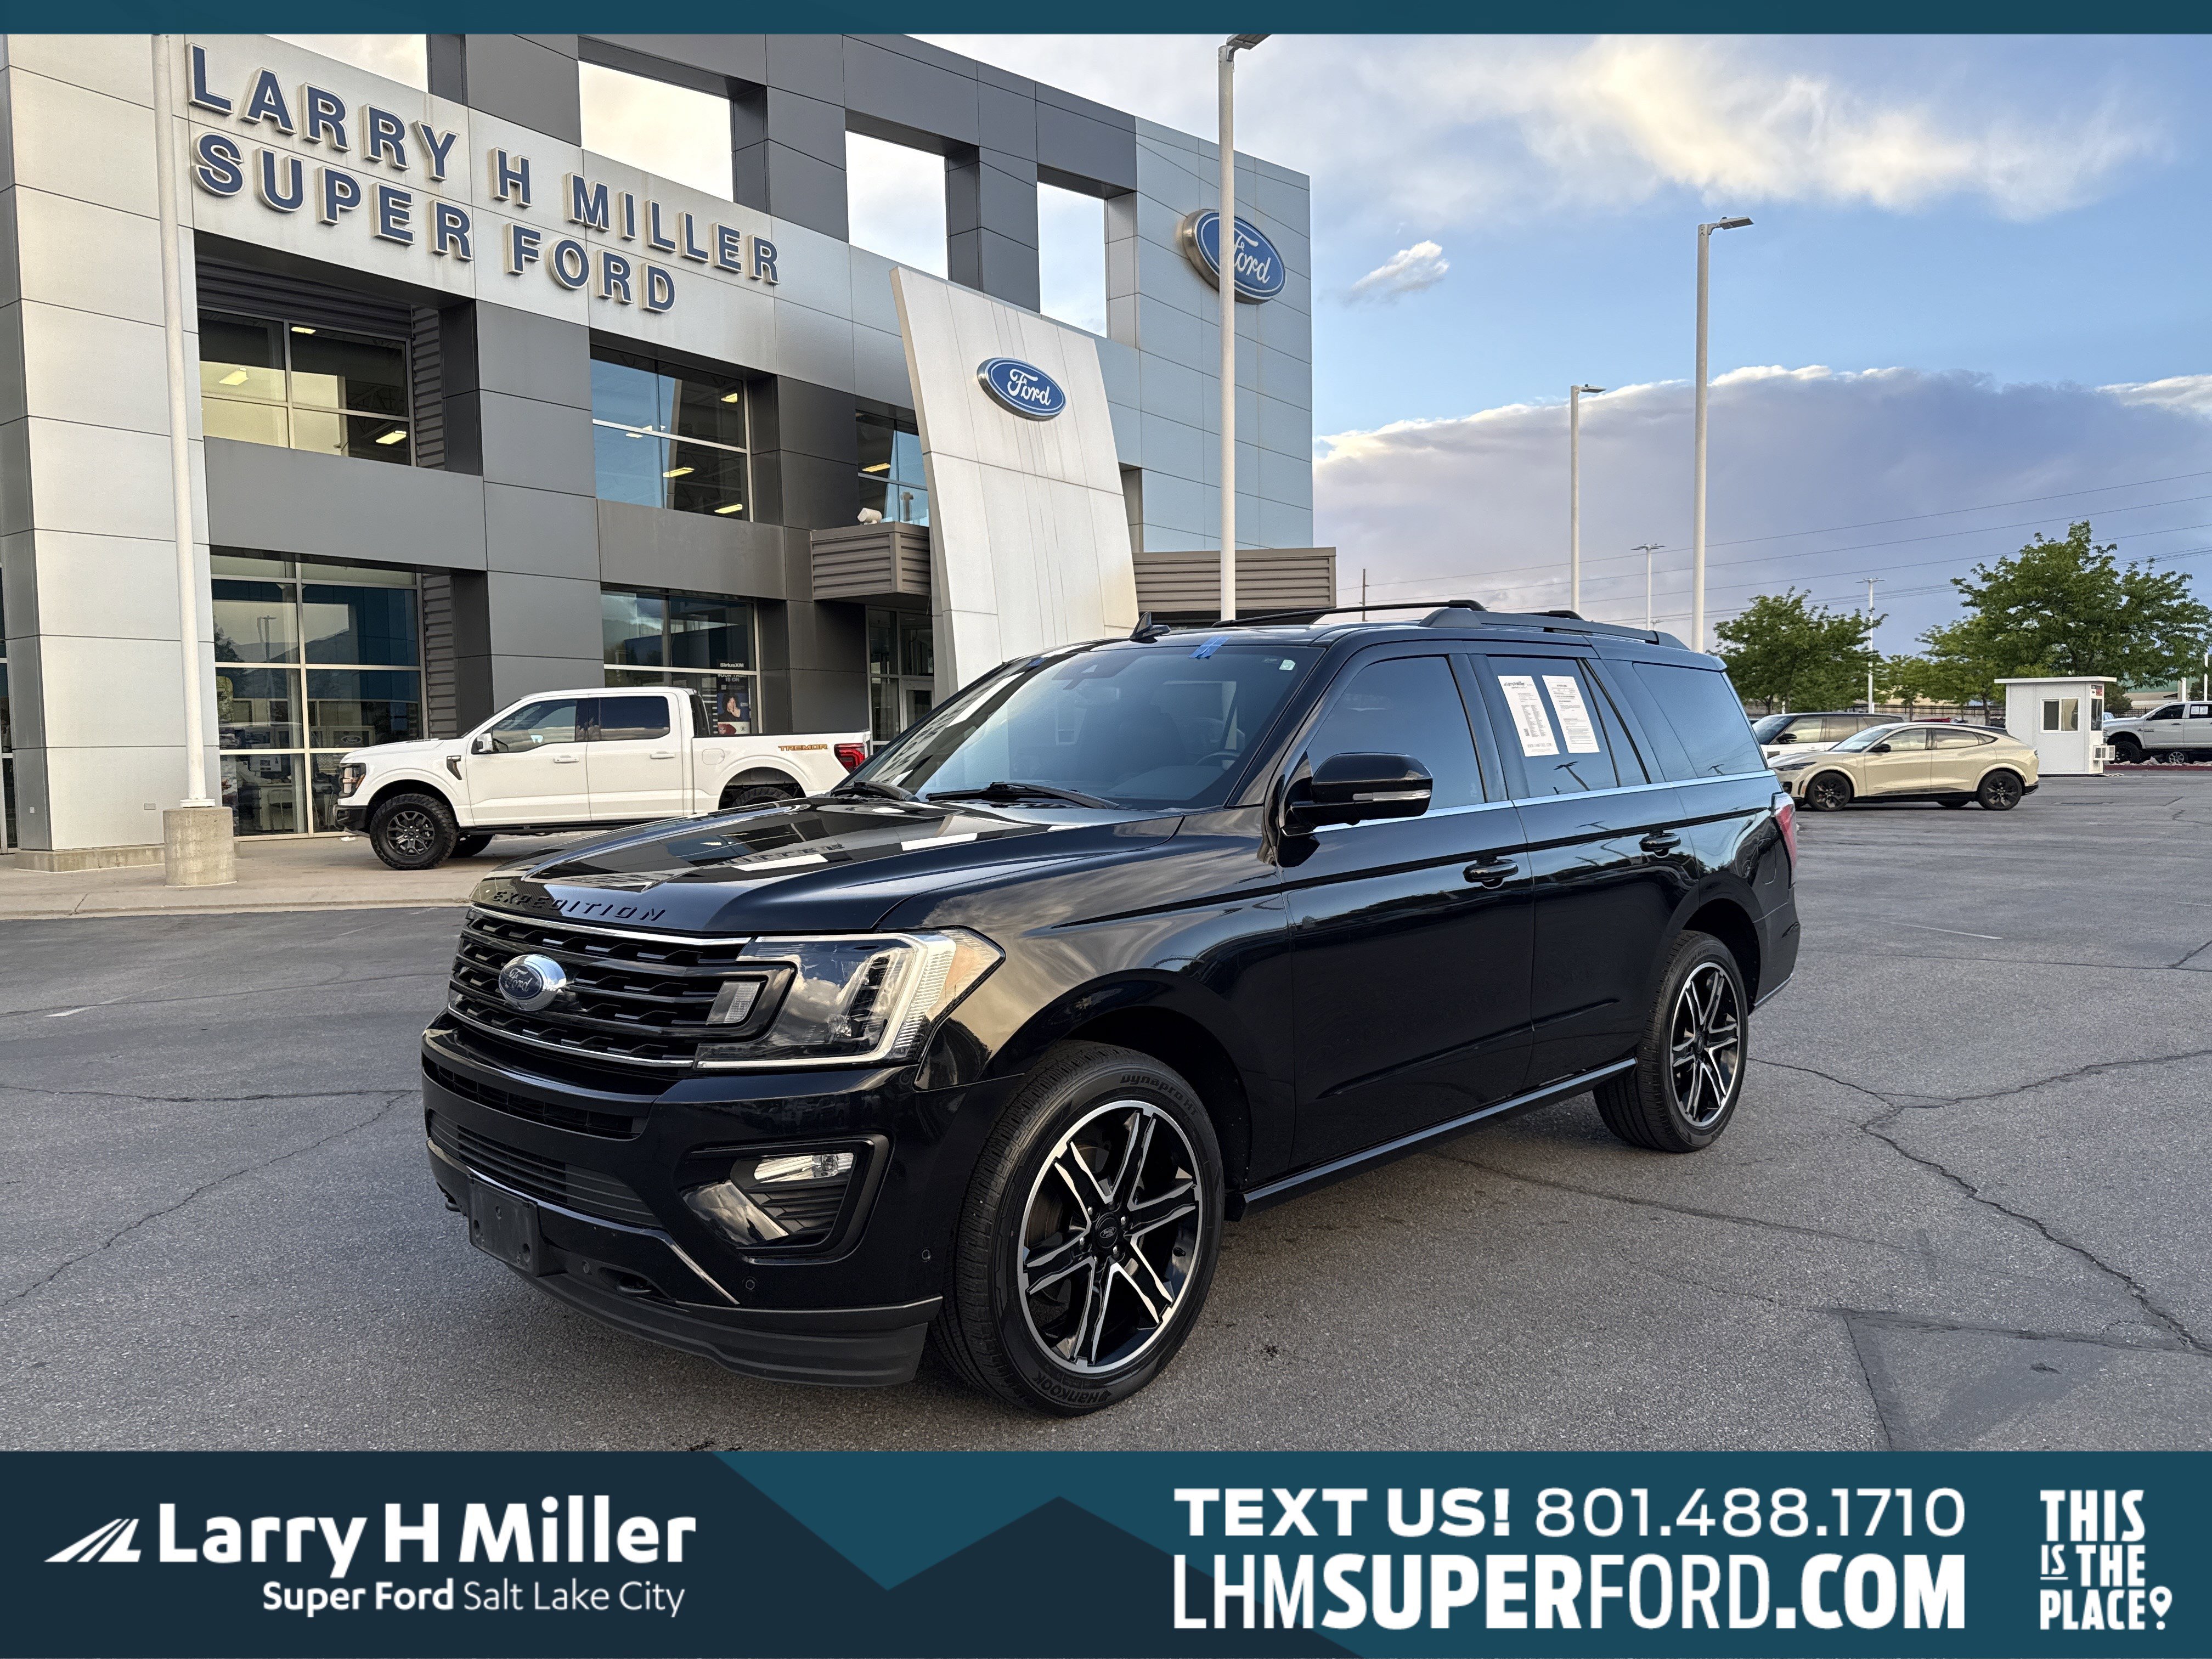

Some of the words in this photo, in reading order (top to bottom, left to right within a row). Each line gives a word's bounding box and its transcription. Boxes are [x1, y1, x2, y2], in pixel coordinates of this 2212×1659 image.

[187, 43, 460, 182] LARRY
[492, 146, 532, 207] H
[565, 171, 780, 286] MILLER
[194, 132, 474, 262] SUPER
[506, 222, 676, 313] FORD
[1007, 368, 1052, 406] Ford
[493, 891, 666, 922] EXPEDITION
[504, 967, 533, 993] Ford
[1120, 1074, 1183, 1101] Dynapro
